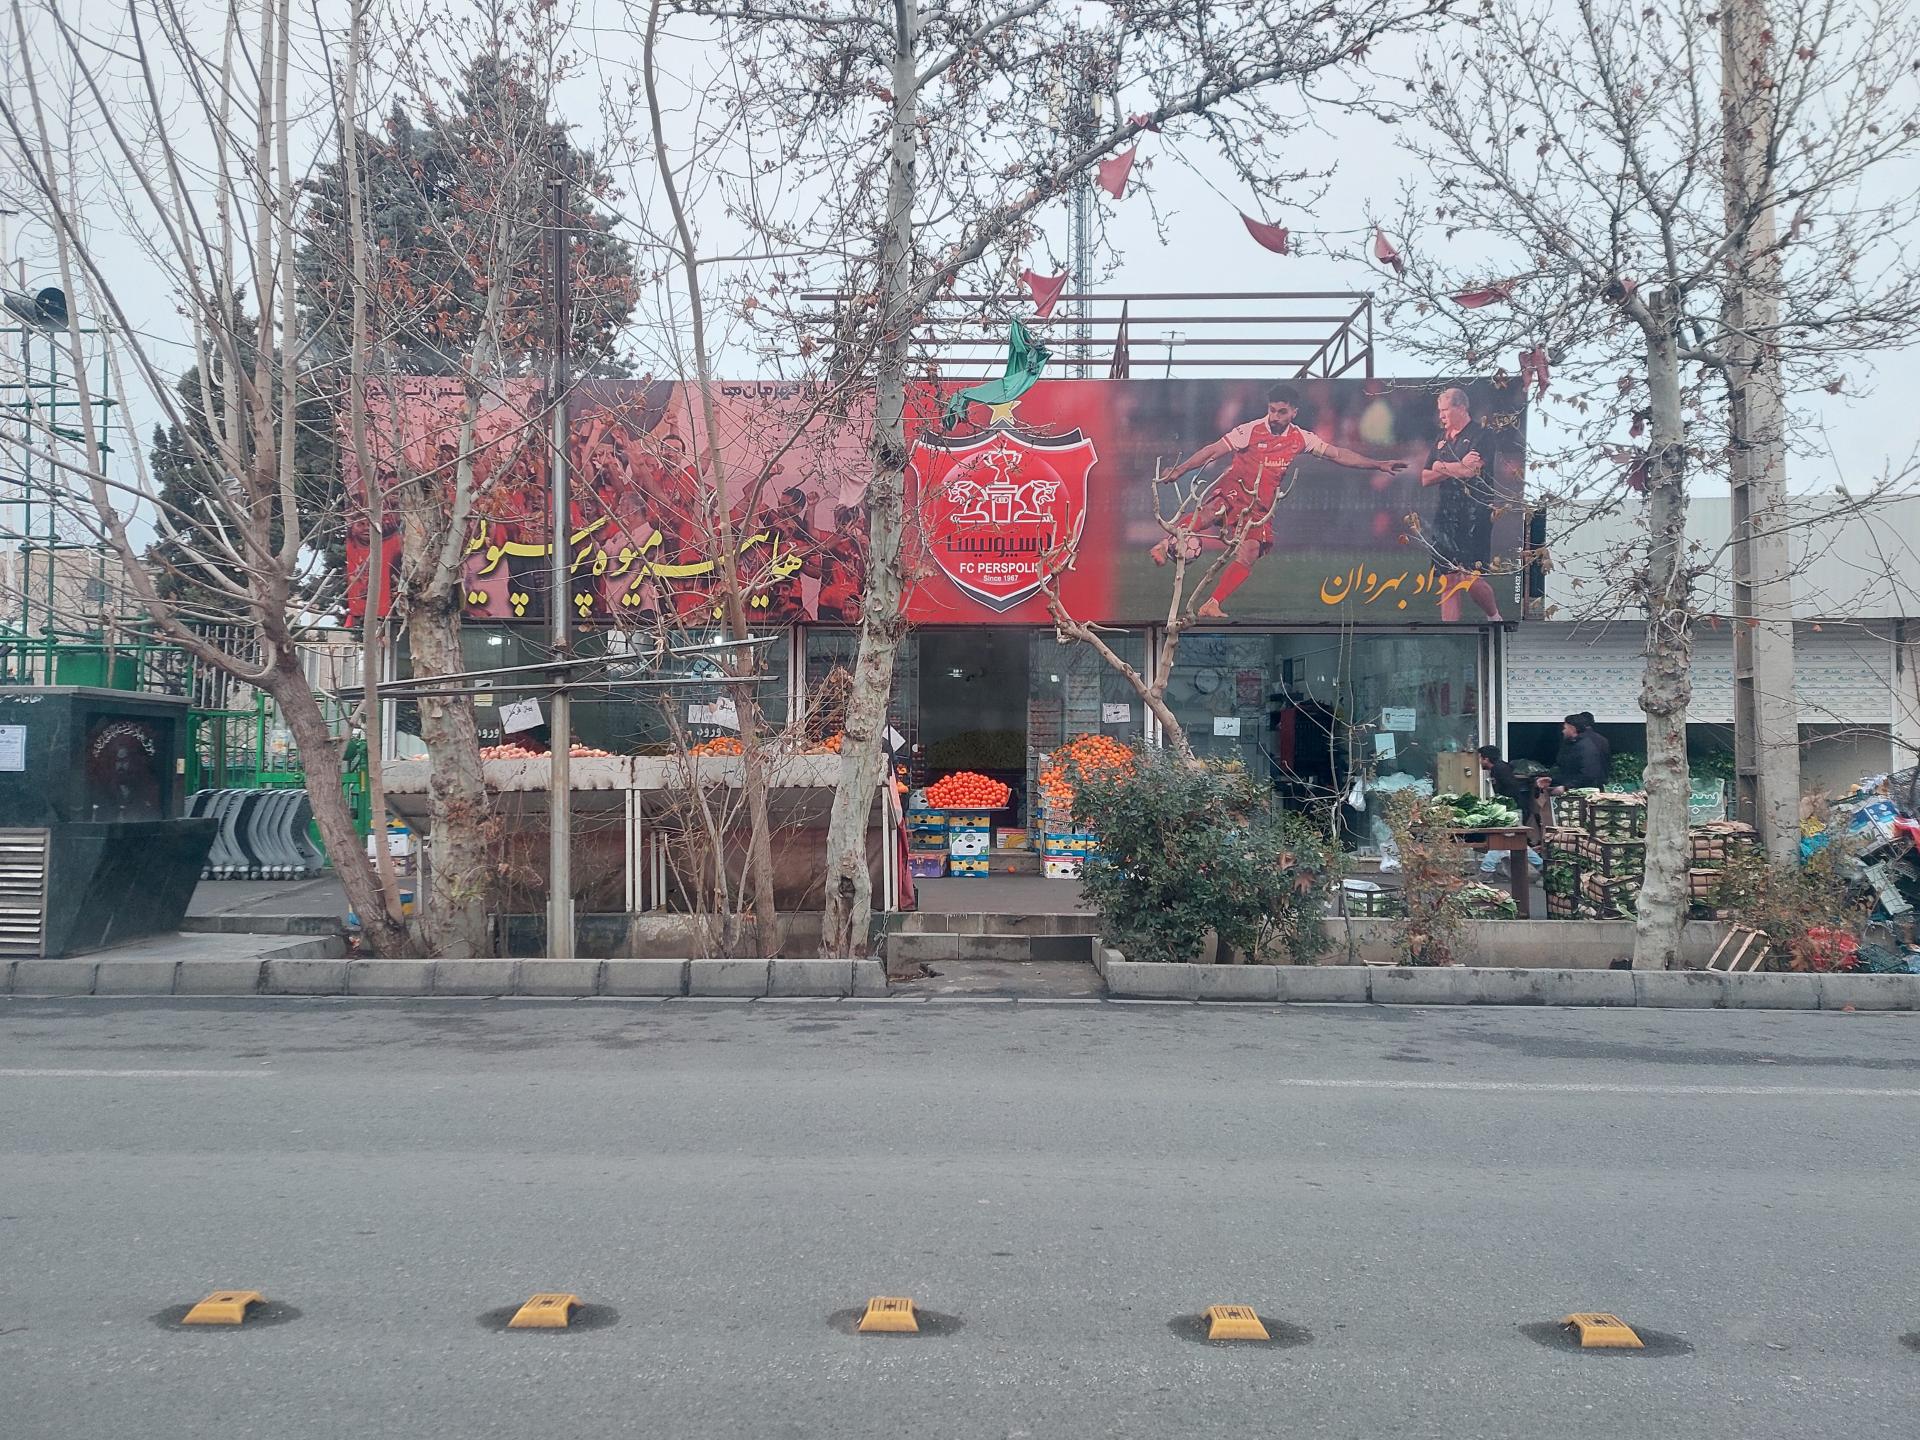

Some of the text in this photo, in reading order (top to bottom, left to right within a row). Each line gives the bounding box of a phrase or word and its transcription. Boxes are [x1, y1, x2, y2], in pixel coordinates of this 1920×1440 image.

[464, 514, 610, 617] پرسپولی
[959, 562, 975, 574] FC
[983, 574, 1019, 582] Since 1967
[1320, 562, 1483, 610] مهرداد بهروان
